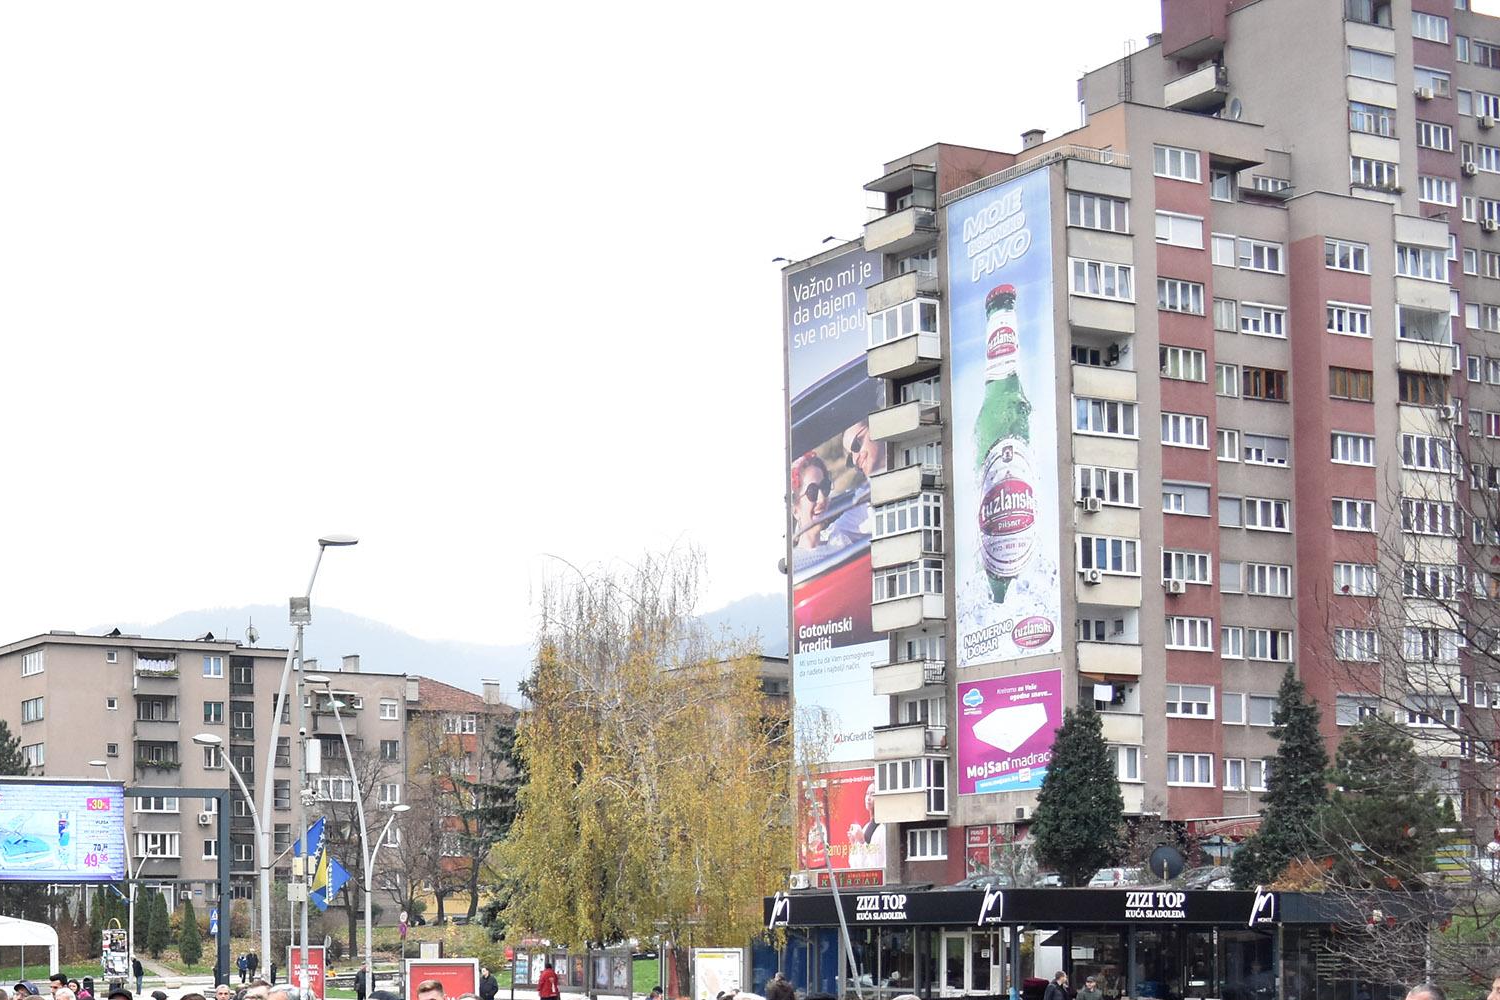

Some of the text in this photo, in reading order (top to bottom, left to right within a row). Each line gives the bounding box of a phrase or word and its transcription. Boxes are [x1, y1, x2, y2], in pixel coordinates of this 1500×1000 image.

[963, 185, 1023, 242] MOJE
[972, 229, 1031, 282] PIVO
[793, 261, 872, 303] Važno mi je
[793, 291, 856, 326] da dajem
[794, 307, 866, 349] sve najbolj
[799, 616, 853, 639] Gotovinski
[964, 619, 1013, 648] NAMJERNO
[1013, 621, 1052, 639] tuzlanski
[799, 636, 832, 654] krediti
[967, 637, 999, 660] DOBAR
[966, 758, 1009, 779] MojSan
[856, 894, 907, 911] ZIZI TOP
[1126, 892, 1186, 908] ZIZI TOP
[856, 910, 907, 921] KUĆA SLADOLEDA
[1125, 908, 1185, 919] KUĆA SLADOLEDA
